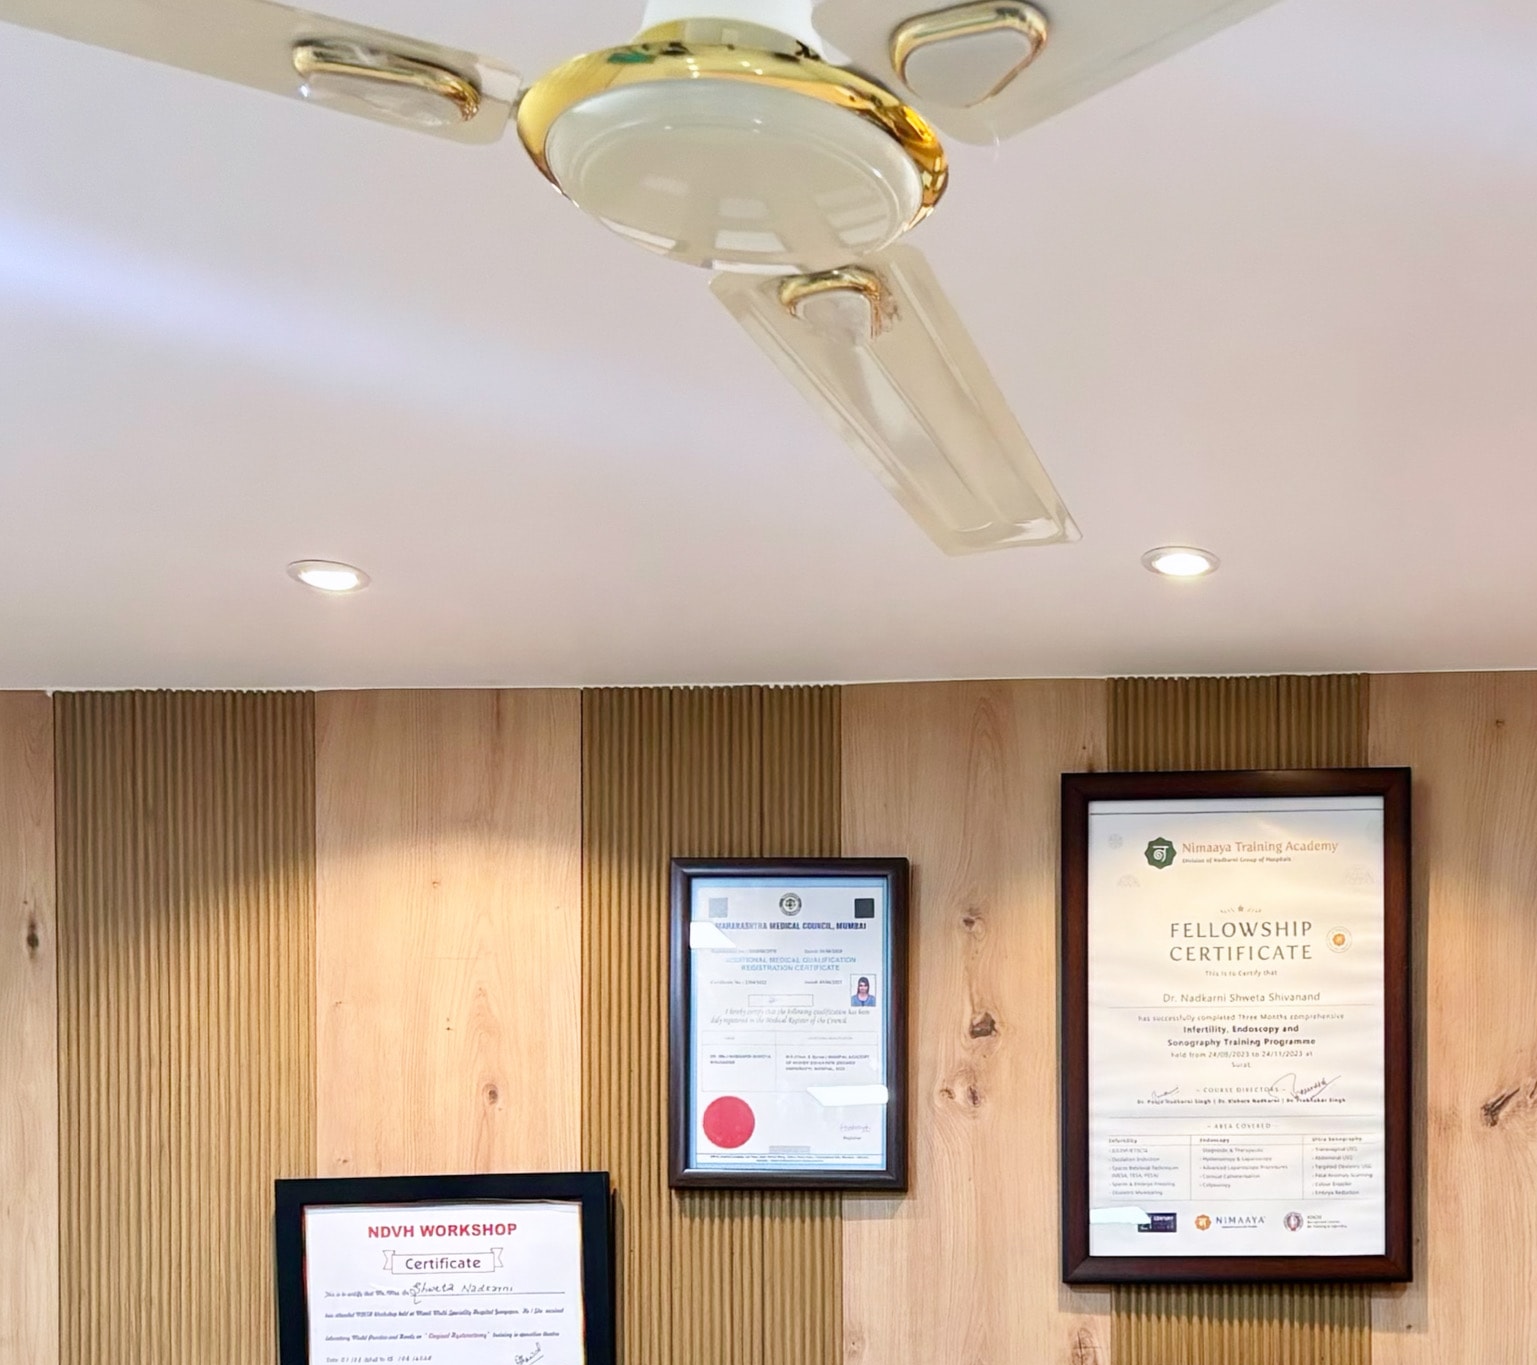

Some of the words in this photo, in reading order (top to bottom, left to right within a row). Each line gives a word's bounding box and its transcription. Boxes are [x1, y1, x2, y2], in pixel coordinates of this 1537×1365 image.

[1235, 841, 1282, 853] Training
[1286, 841, 1338, 853] Academy
[1171, 921, 1312, 938] FELLOWSHIP
[1170, 945, 1312, 961] CERTIFICATE
[1163, 994, 1177, 1002] Dr.
[1181, 993, 1226, 1002] Nadkarni
[1230, 993, 1265, 1002] Shweta
[1269, 992, 1320, 1001] Shivanand
[1232, 1025, 1279, 1034] Endoscopy
[1168, 1039, 1221, 1047] Sonography
[1224, 1038, 1261, 1047] Training
[1264, 1038, 1316, 1046] Programme
[368, 1226, 414, 1238] NDVH
[420, 1223, 517, 1237] WORKSHOP
[406, 1258, 481, 1270] Certificate
